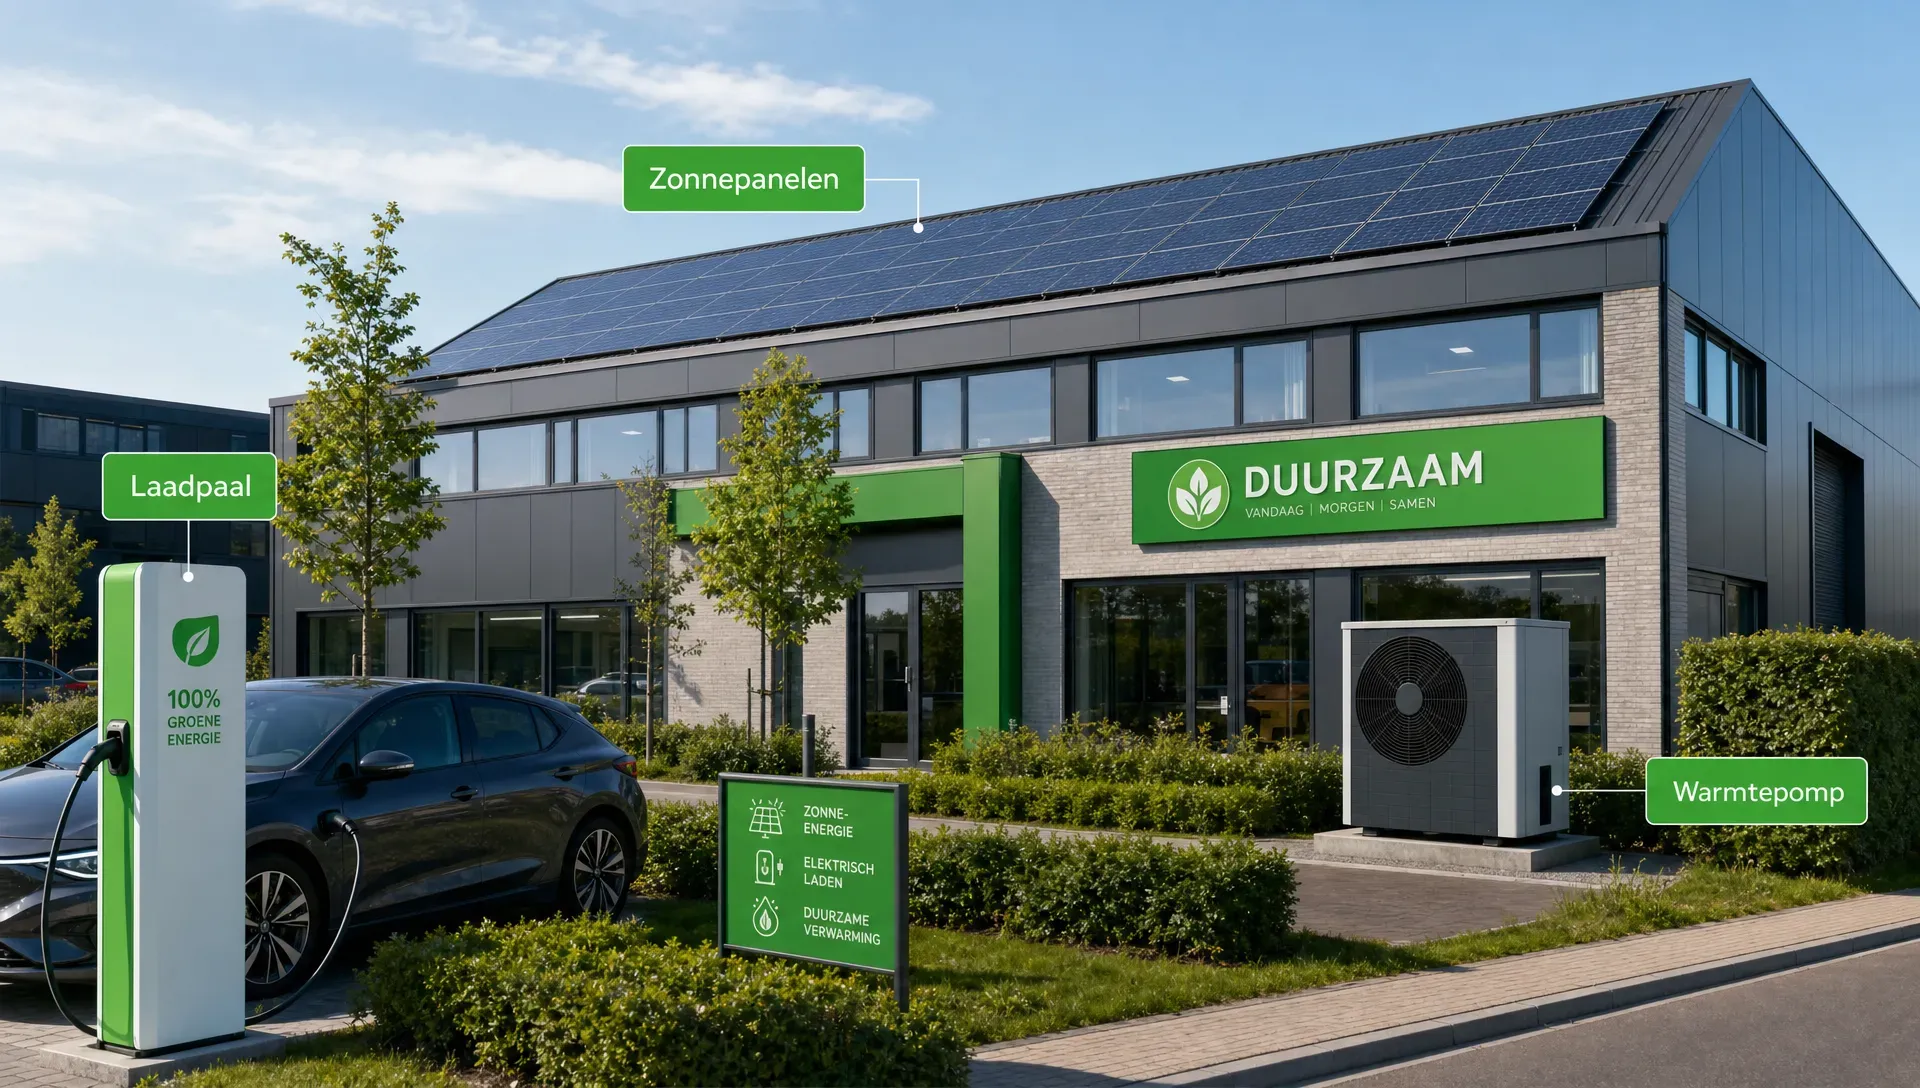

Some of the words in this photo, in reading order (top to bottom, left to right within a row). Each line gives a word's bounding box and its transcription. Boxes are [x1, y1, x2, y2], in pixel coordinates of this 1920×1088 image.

[1245, 450, 1483, 499] DUURZAAM
[1245, 504, 1304, 519] VANDAAG
[1319, 500, 1375, 514] MORGEN
[1389, 497, 1436, 510] SAMEN
[167, 688, 221, 710] 100%
[167, 714, 221, 729] GROENE
[167, 731, 221, 746] ENERGIE
[803, 805, 849, 820] ZONNE-
[803, 822, 854, 838] ENERGIE
[804, 856, 874, 876] ELEKTRISCH
[804, 873, 843, 889] LADEN
[803, 906, 870, 928] DUURZAME
[803, 923, 881, 946] VERWARMING
